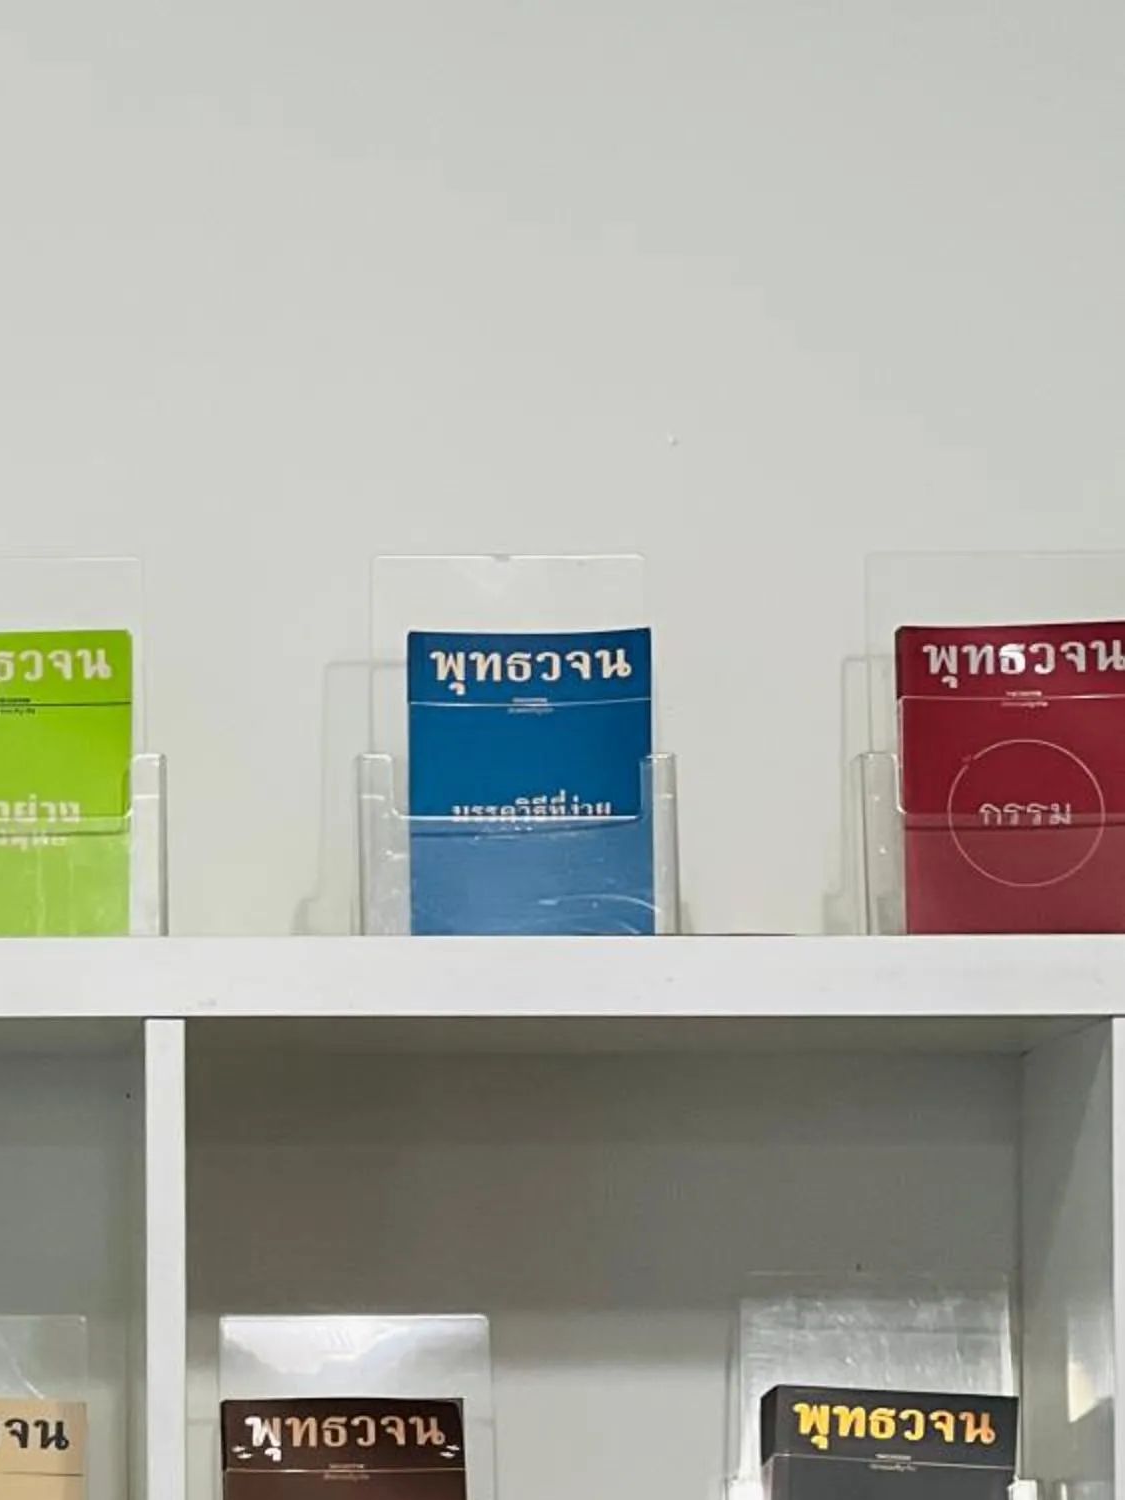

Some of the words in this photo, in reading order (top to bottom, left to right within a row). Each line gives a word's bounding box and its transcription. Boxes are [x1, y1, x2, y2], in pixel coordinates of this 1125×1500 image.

[430, 649, 632, 695] พุทธวจน
[923, 639, 1125, 688] พุทธวจน
[979, 803, 1071, 825] กรรม
[245, 1415, 445, 1461] พุทธวจน
[793, 1403, 996, 1449] พุทธวจน
